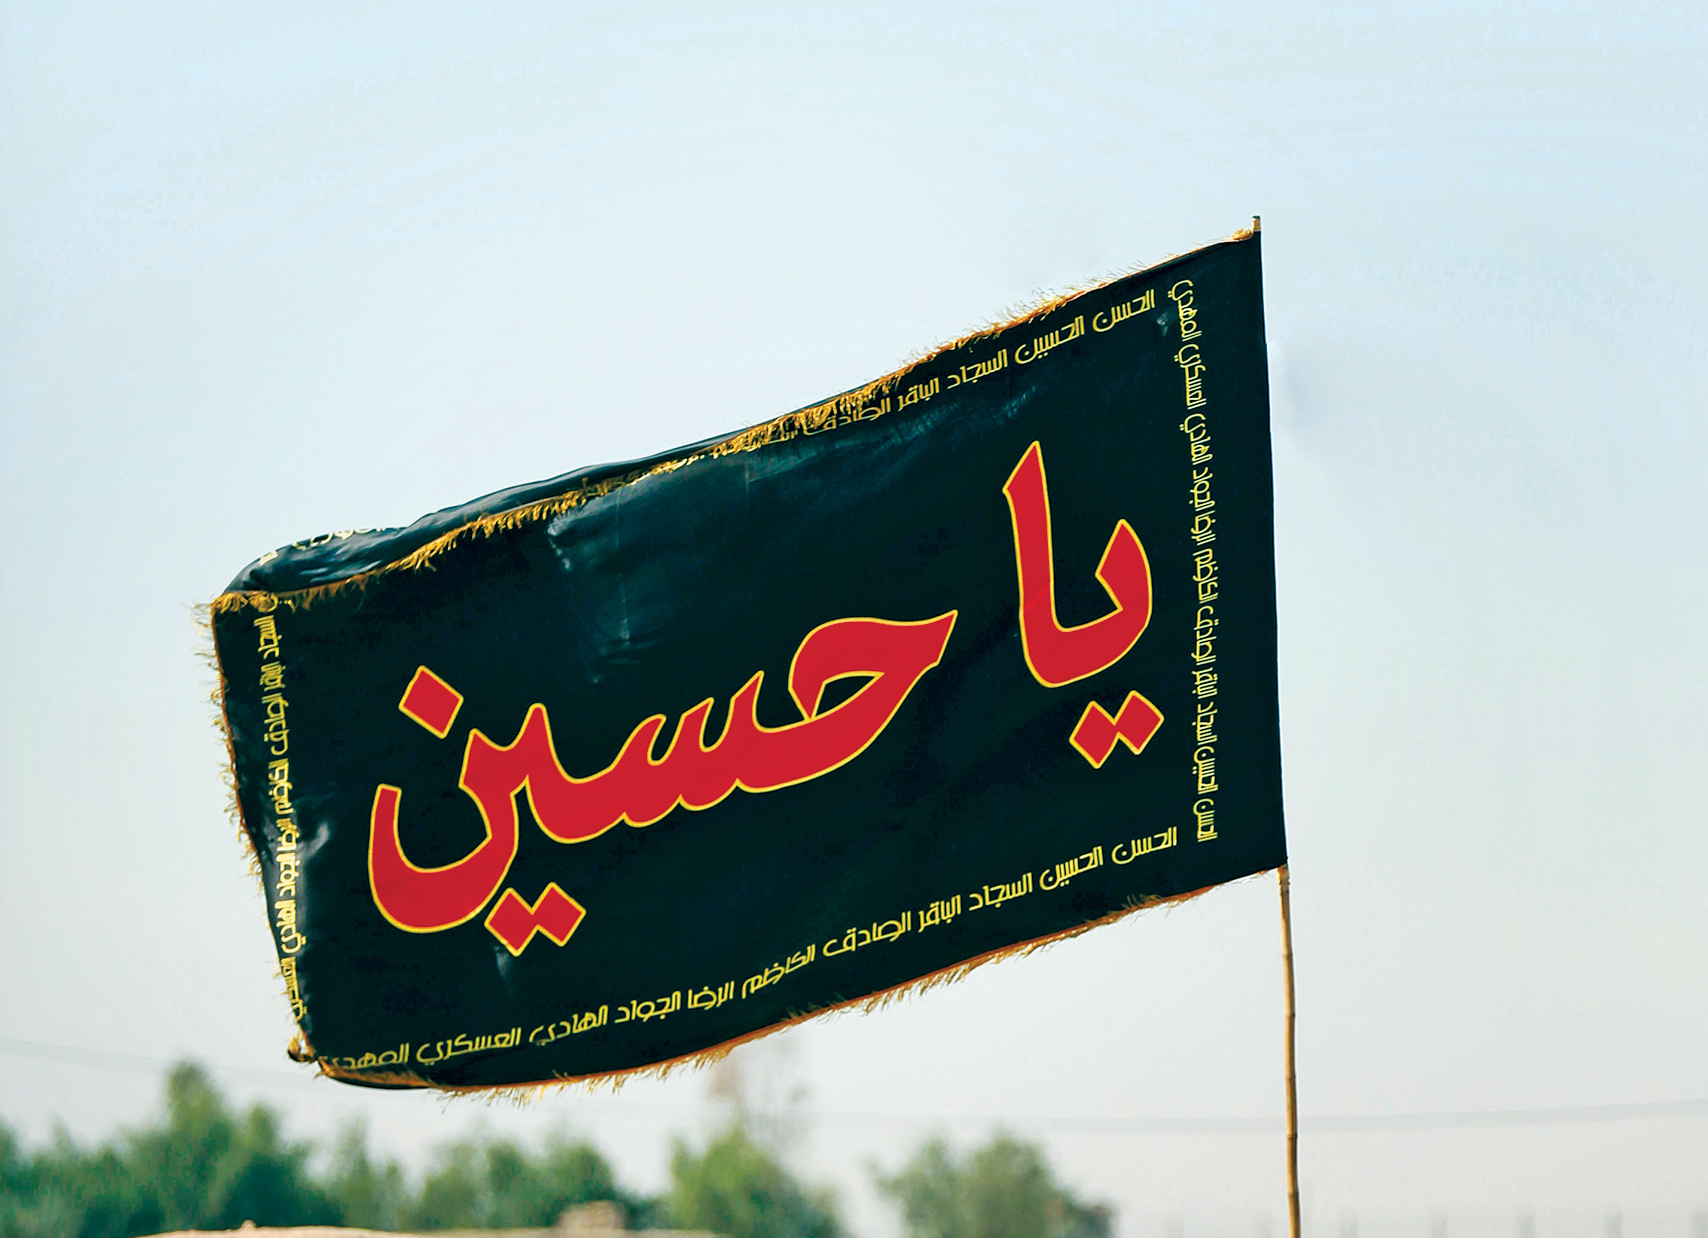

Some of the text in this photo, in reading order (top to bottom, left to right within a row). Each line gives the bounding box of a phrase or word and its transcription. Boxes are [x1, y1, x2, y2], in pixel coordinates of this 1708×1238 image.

[1092, 289, 1156, 333] الحسن
[1014, 315, 1085, 365] الحسين
[948, 348, 1008, 387] السجاد
[898, 377, 940, 411] الباقر
[1167, 279, 1219, 842] الحسن الحسين السجاد الباقر الصادق الكاظم الرضا الجواد الهادي العسكري المهدي
[369, 440, 1164, 956] يا حسين
[1111, 826, 1178, 865] الحسن
[1039, 846, 1104, 891] الحسين
[968, 873, 1033, 911] السجاد
[918, 894, 962, 933] الباقر
[822, 911, 912, 957] الصادق
[741, 944, 816, 999] الكاظم
[614, 990, 682, 1023] الجواد
[687, 980, 735, 1010] الرضا
[528, 1004, 608, 1046] الهادي
[416, 1027, 521, 1065] العسكري
